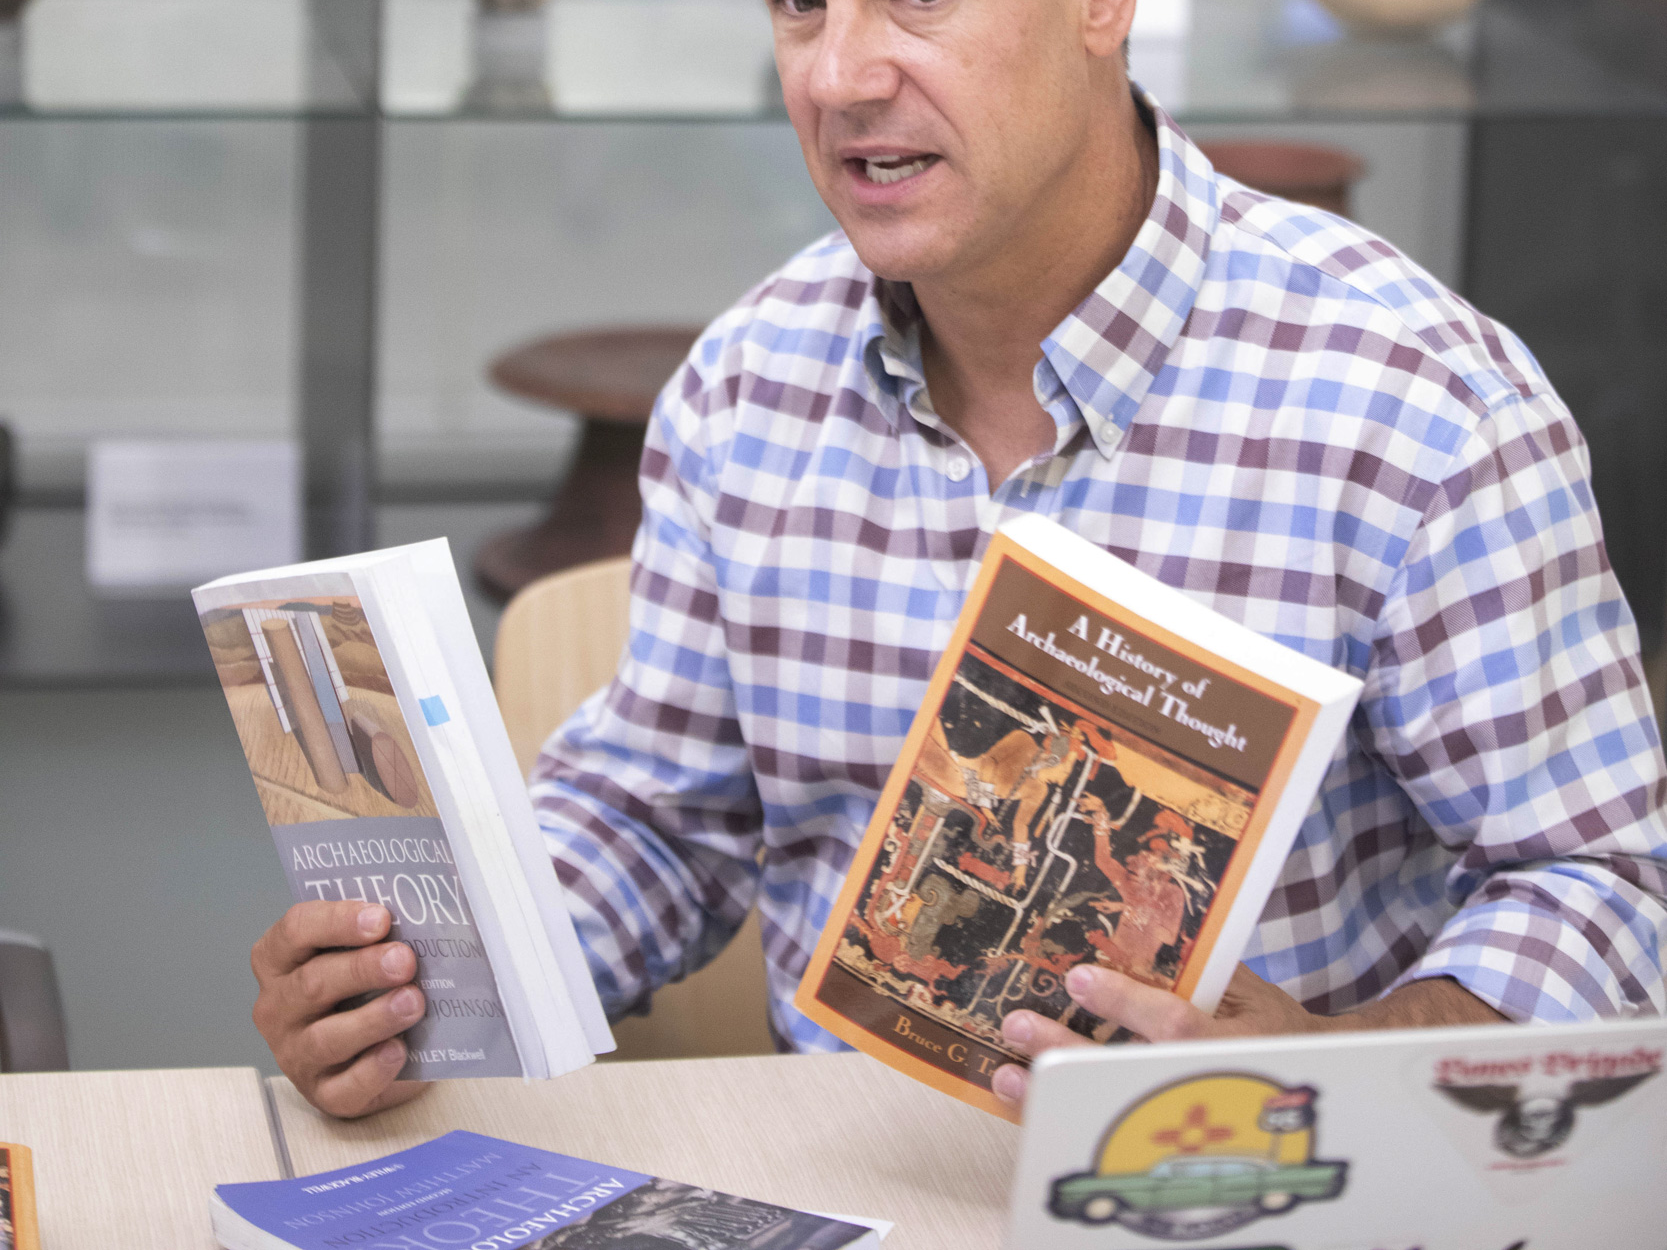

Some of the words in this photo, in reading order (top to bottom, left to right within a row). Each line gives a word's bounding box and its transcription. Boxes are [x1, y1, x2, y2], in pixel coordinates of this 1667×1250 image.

[1067, 614, 1089, 641] A
[1095, 626, 1178, 691] History
[1181, 678, 1211, 700] of
[1005, 613, 1155, 708] Archaeological
[1158, 690, 1247, 752] Thought
[293, 838, 453, 871] ARCHAEOLOGICAL
[420, 979, 455, 989] EDITION
[431, 999, 506, 1020] JOHNSON
[408, 1050, 448, 1063] WILEY
[893, 1014, 943, 1054] Bruce
[947, 1043, 969, 1066] G.
[394, 1152, 502, 1199] MATTHEW
[506, 1162, 542, 1182] AN
[283, 1192, 394, 1230] JOHNSON
[323, 1179, 509, 1248] INTRODUCTION
[467, 1177, 624, 1250] ARCHAEOLO
